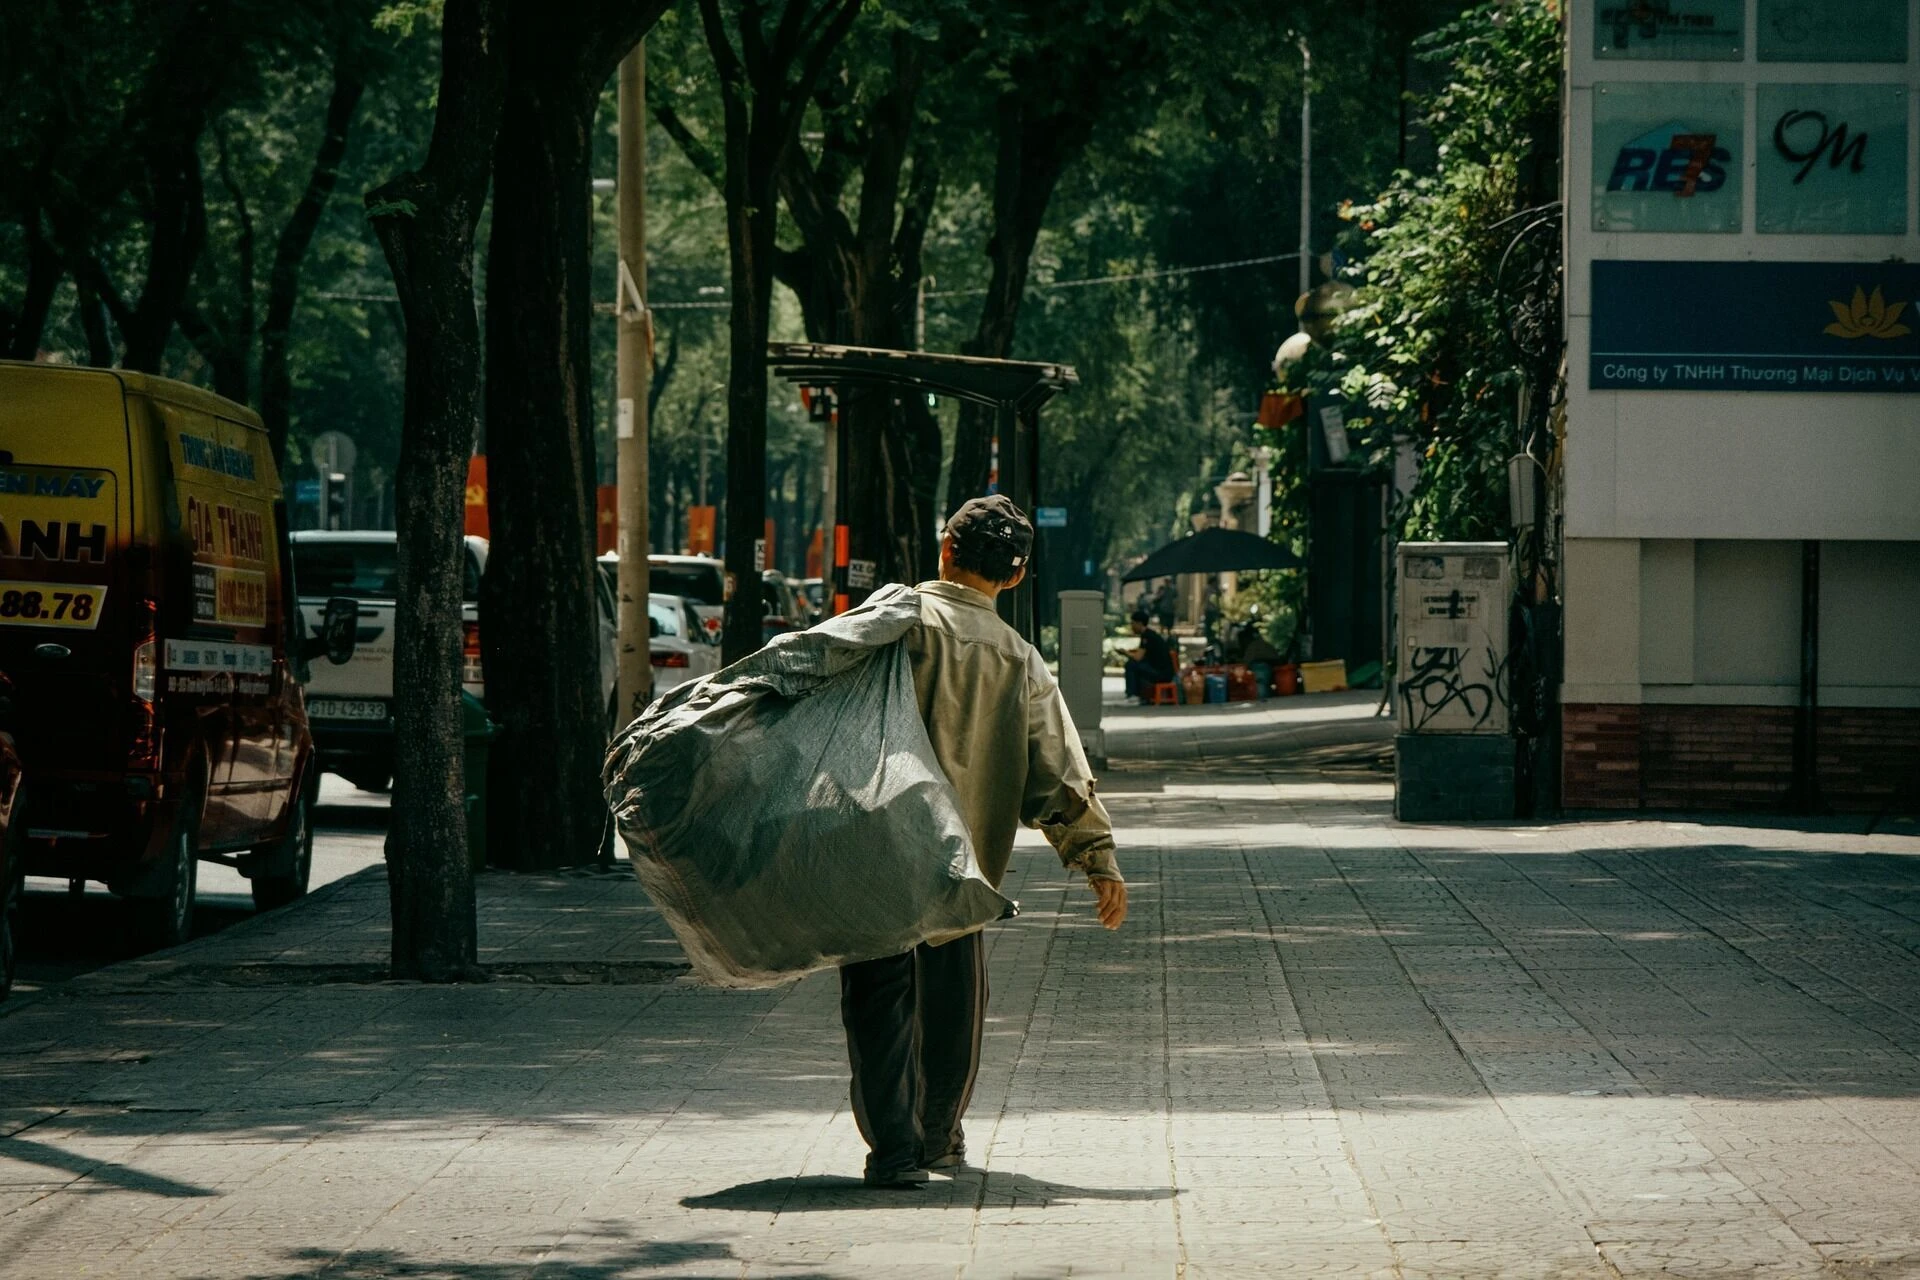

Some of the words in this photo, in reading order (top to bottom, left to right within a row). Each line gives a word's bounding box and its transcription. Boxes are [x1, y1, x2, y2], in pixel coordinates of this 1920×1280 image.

[1603, 363, 1648, 382] Công
[1653, 364, 1668, 382] ty
[1674, 364, 1724, 380] TNHH
[1730, 365, 1797, 384] Thương
[1803, 366, 1832, 384] Mại
[1839, 366, 1876, 384] Dịch
[34, 472, 105, 498] MÁY
[188, 495, 215, 556] GIA
